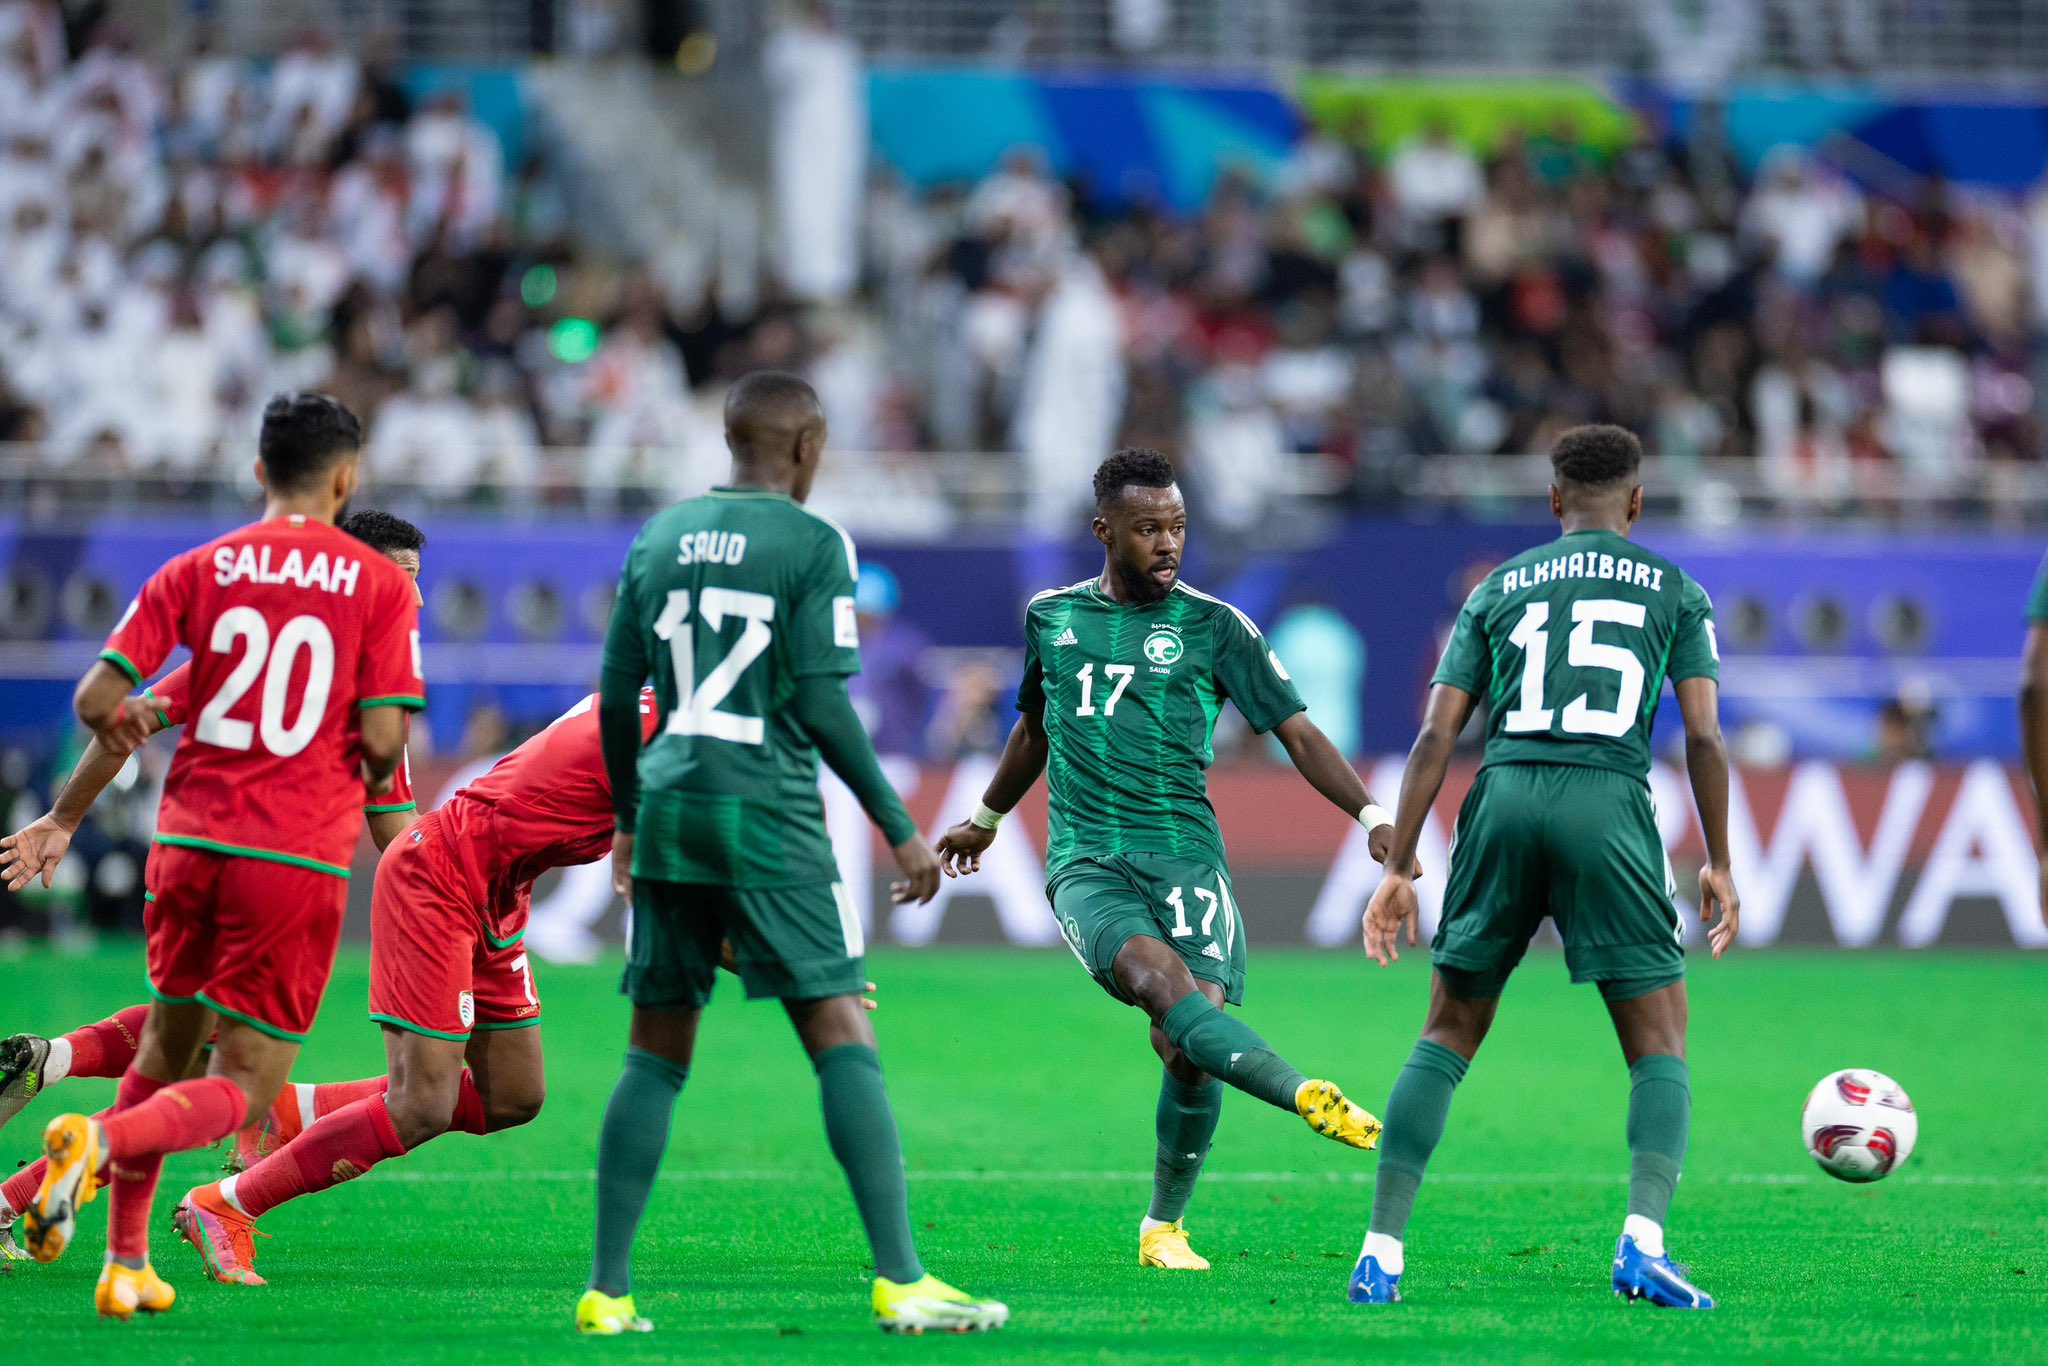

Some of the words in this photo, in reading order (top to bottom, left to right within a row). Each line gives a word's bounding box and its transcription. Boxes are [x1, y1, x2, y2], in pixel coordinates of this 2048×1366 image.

[213, 544, 361, 597] SALAAH
[676, 530, 747, 566] SAUD
[1503, 551, 1664, 594] ALKHAIBARI
[652, 586, 776, 745] 12
[1053, 638, 1078, 647] adidas
[1504, 599, 1647, 737] 15
[194, 605, 335, 757] 20
[1075, 663, 1136, 717] 17
[1149, 666, 1171, 675] SAUDI
[1165, 886, 1219, 938] 17
